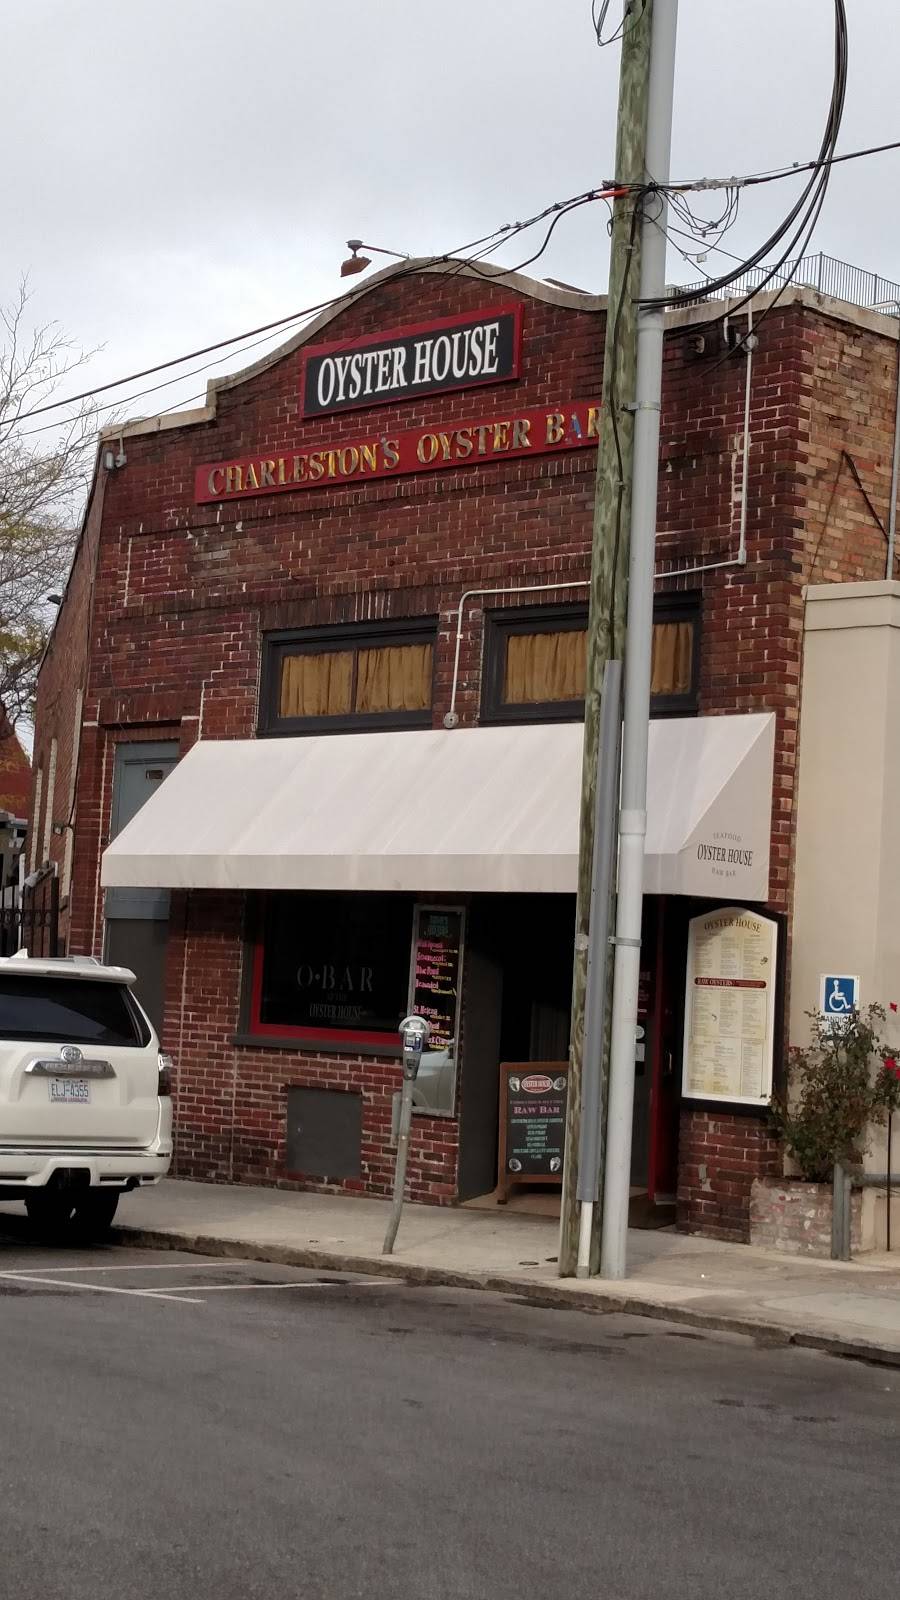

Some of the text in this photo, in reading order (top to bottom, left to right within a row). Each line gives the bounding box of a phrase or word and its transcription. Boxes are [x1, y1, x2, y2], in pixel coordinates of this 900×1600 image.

[316, 322, 500, 407] OYSTER HOUSE
[207, 406, 601, 497] CHARLESTON'S OYSTER BAR
[697, 843, 753, 867] OYSTER HOUSE
[704, 917, 762, 933] OYSTER HOUSE
[309, 1003, 336, 1018] OYSTER
[513, 1106, 560, 1114] RAW BAR
